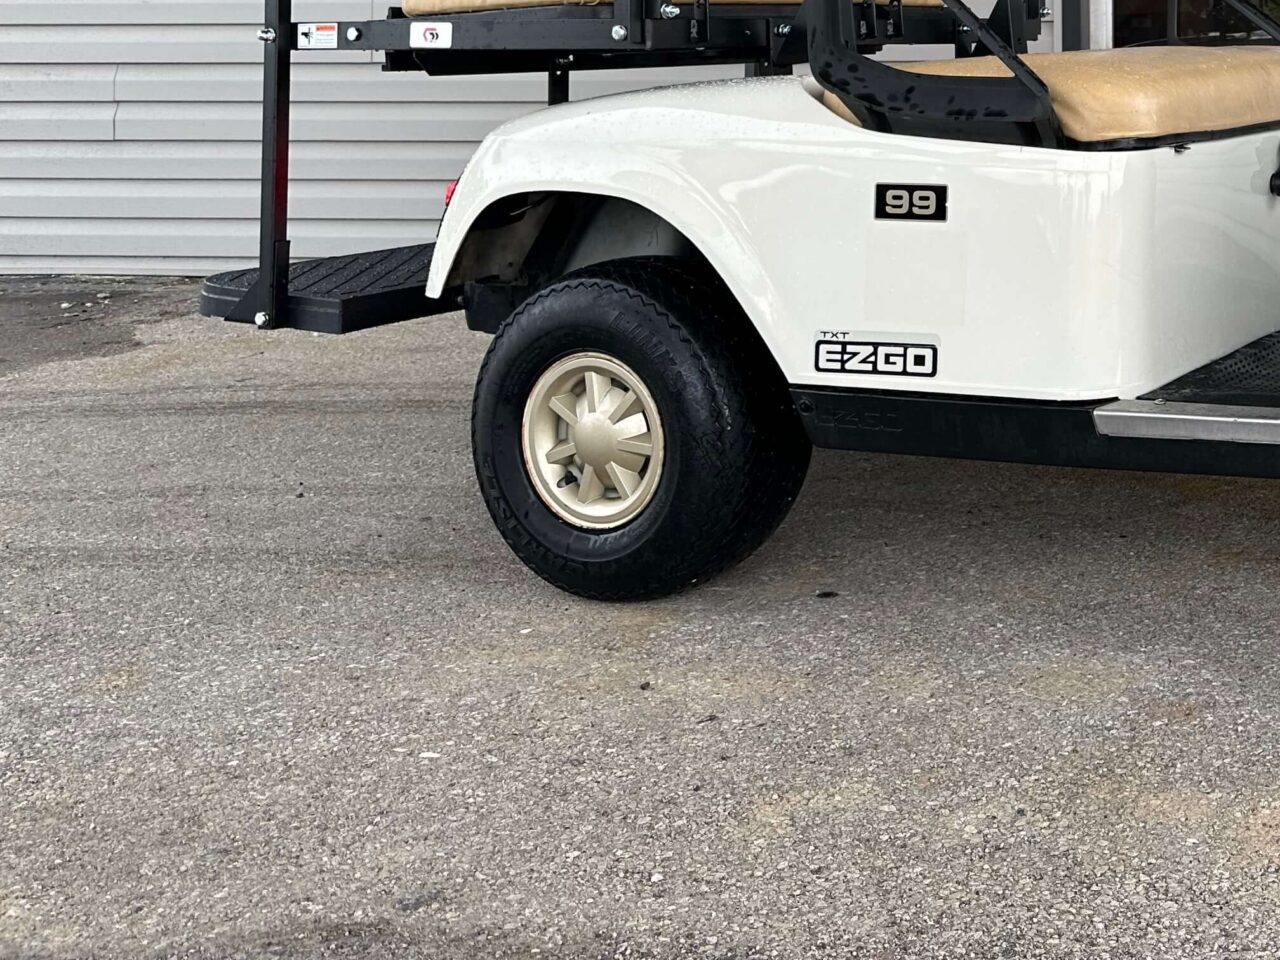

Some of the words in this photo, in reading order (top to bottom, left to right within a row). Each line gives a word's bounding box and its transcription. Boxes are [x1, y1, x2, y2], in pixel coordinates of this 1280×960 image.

[885, 189, 937, 215] 99
[819, 331, 850, 339] TXT
[817, 343, 935, 375] EZGO
